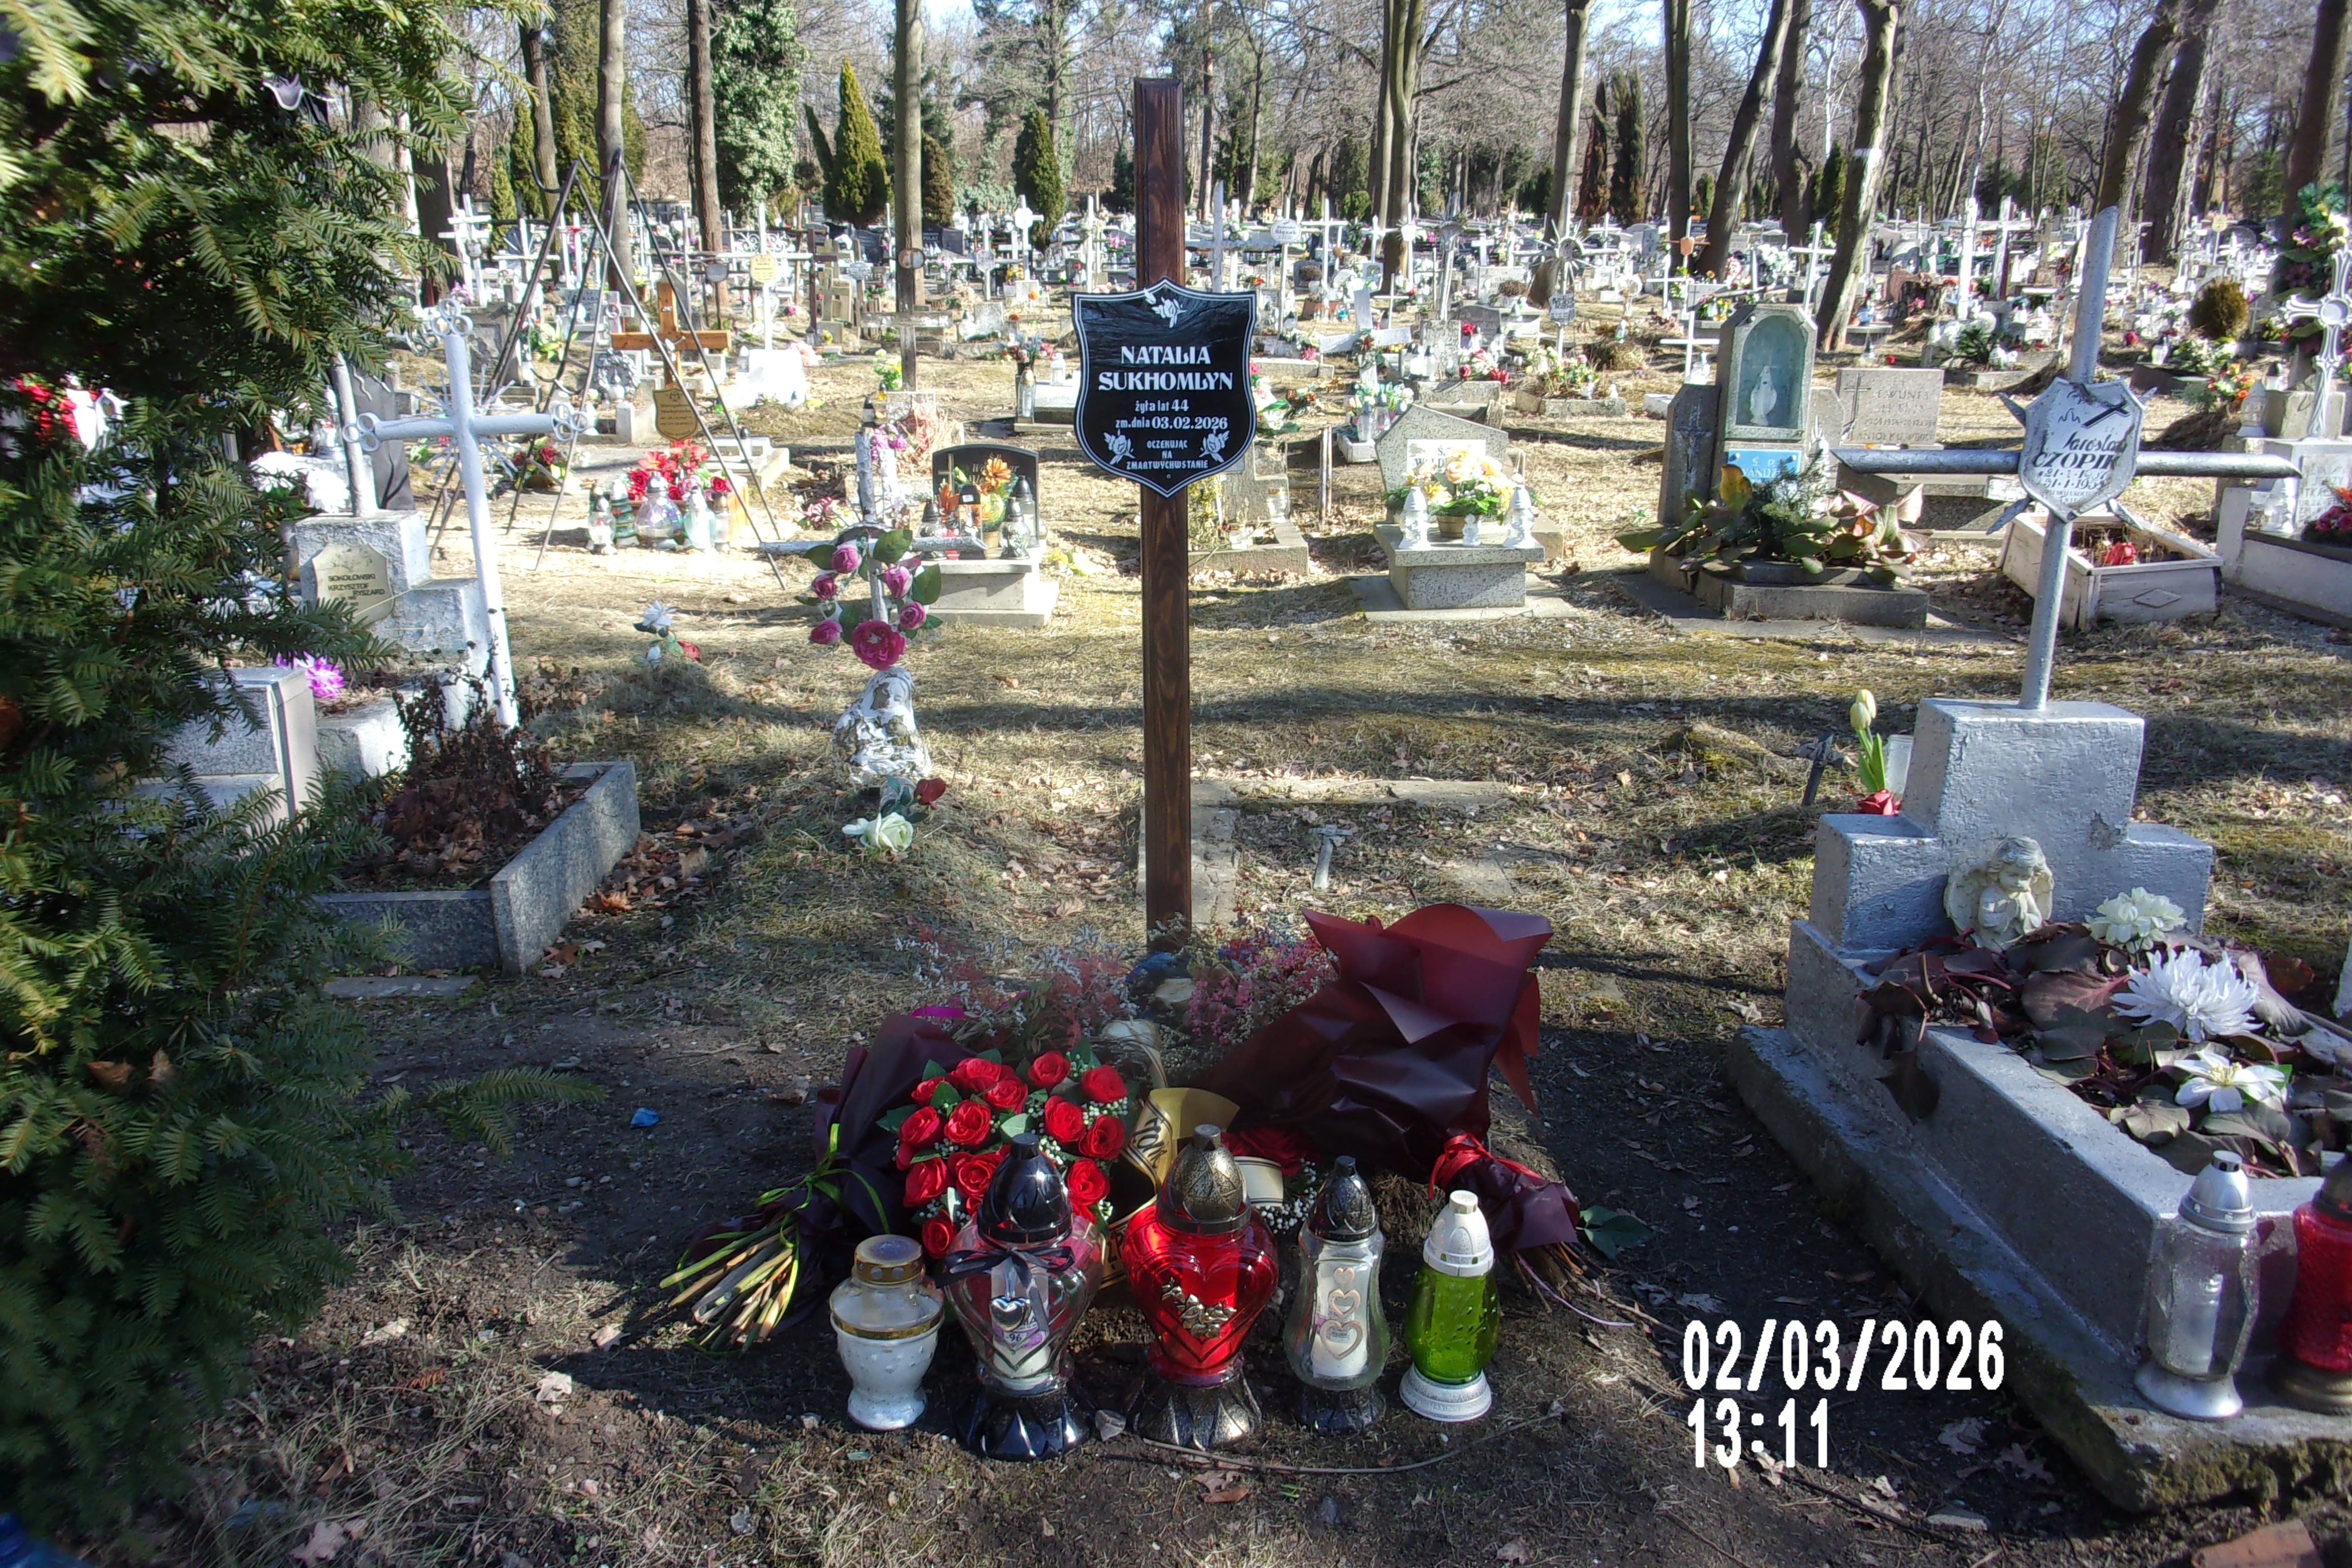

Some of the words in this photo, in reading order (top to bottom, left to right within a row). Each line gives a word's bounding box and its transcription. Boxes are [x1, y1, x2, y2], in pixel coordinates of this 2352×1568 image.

[1121, 346, 1211, 364] NATALIA
[1098, 372, 1234, 390] SUKHOMLYN
[1135, 400, 1156, 414] żyła
[1157, 400, 1170, 412] lat
[1171, 399, 1189, 412] 44
[1115, 416, 1150, 428] zm.dnia
[1152, 416, 1228, 429] 03.02.2026
[1146, 440, 1188, 450] OCZEKUJĄC
[1162, 450, 1172, 459] NA
[1126, 460, 1209, 470] ZMARTWYCHWSTANIE
[2033, 452, 2119, 470] CZOPIK
[328, 583, 370, 591] KRZYSZTOF
[352, 589, 385, 597] RYSZARD
